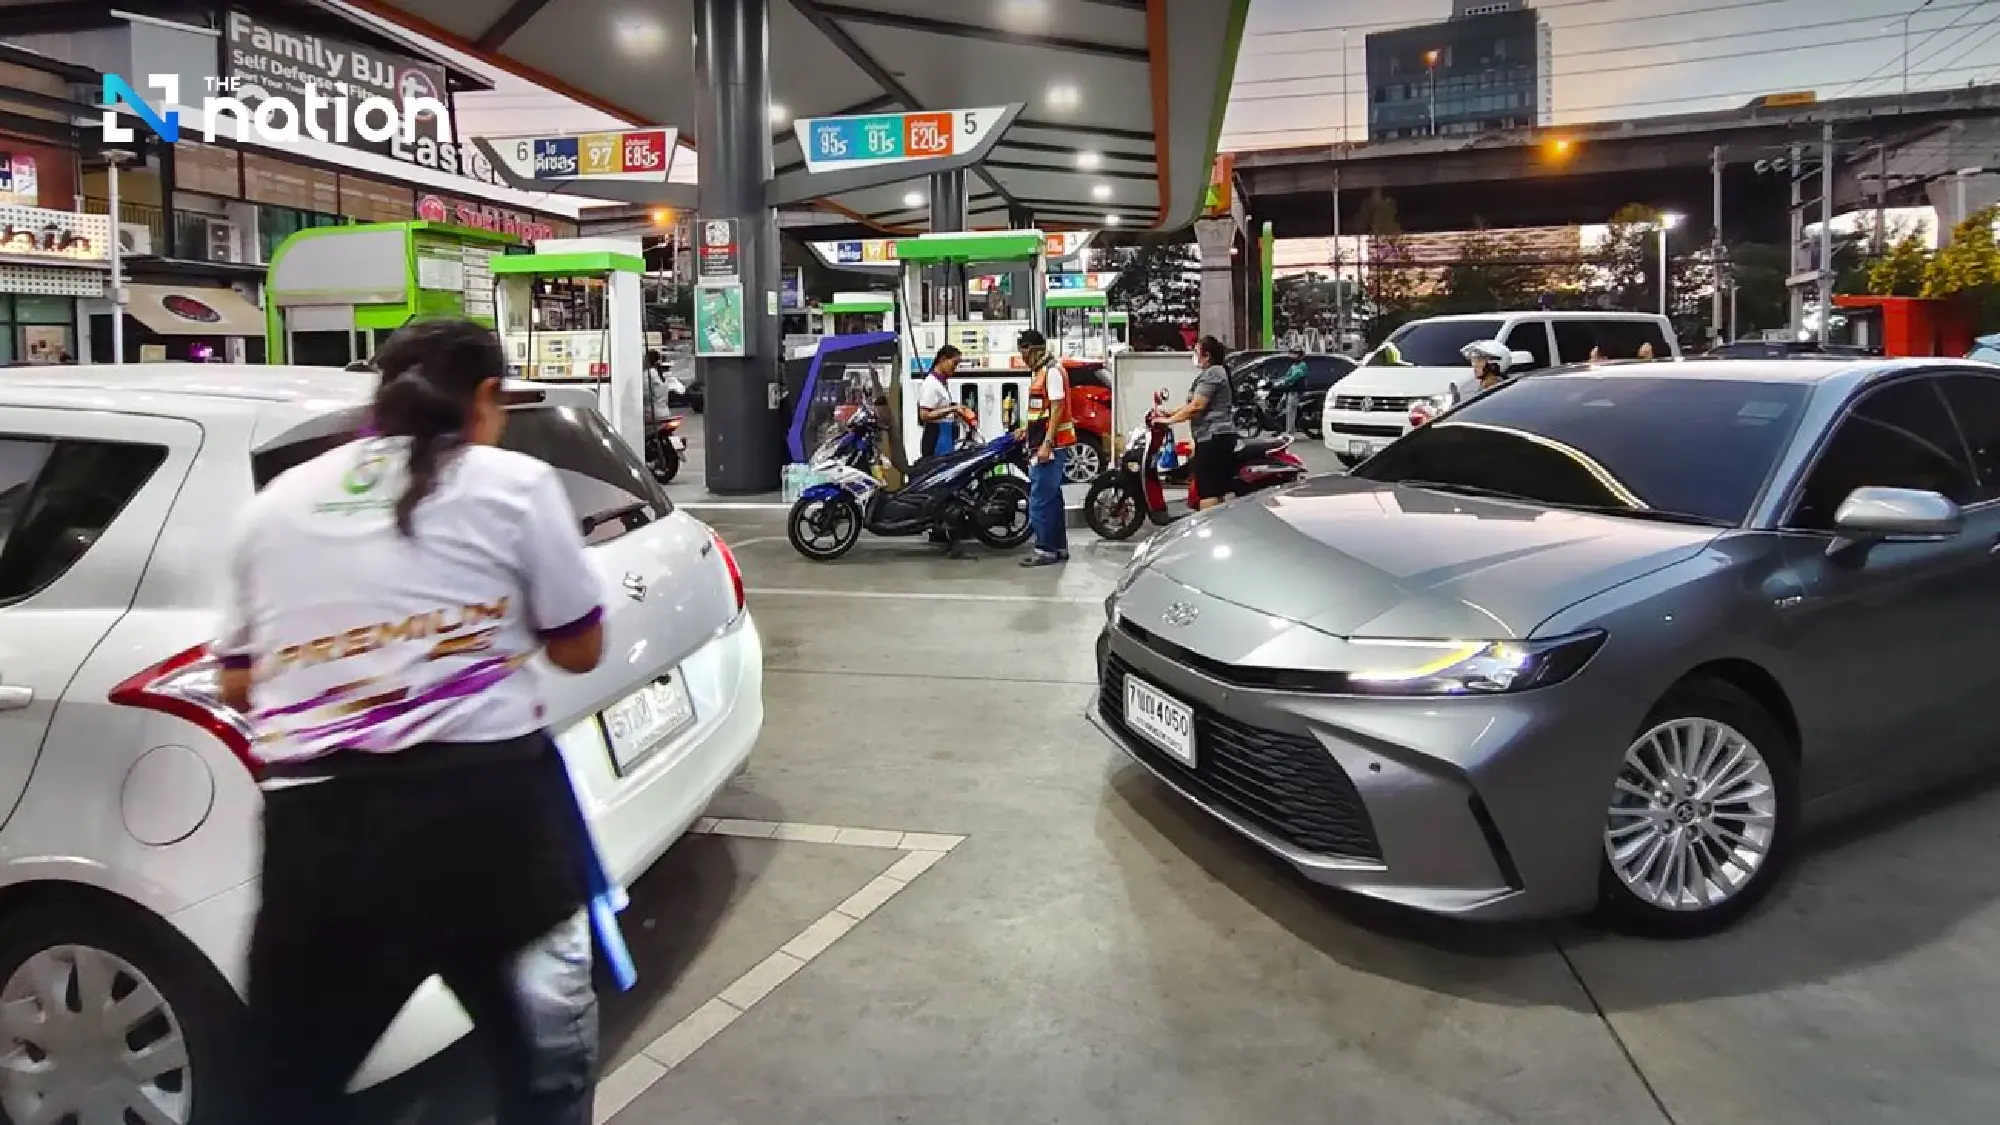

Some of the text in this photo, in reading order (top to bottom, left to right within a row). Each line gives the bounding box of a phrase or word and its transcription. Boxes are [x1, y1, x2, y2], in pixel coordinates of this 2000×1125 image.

[230, 11, 395, 90] Family BJJ
[233, 50, 267, 72] Self
[964, 112, 978, 135] 5
[516, 141, 529, 163] 6
[590, 147, 612, 167] 97
[1157, 701, 1189, 737] 4050
